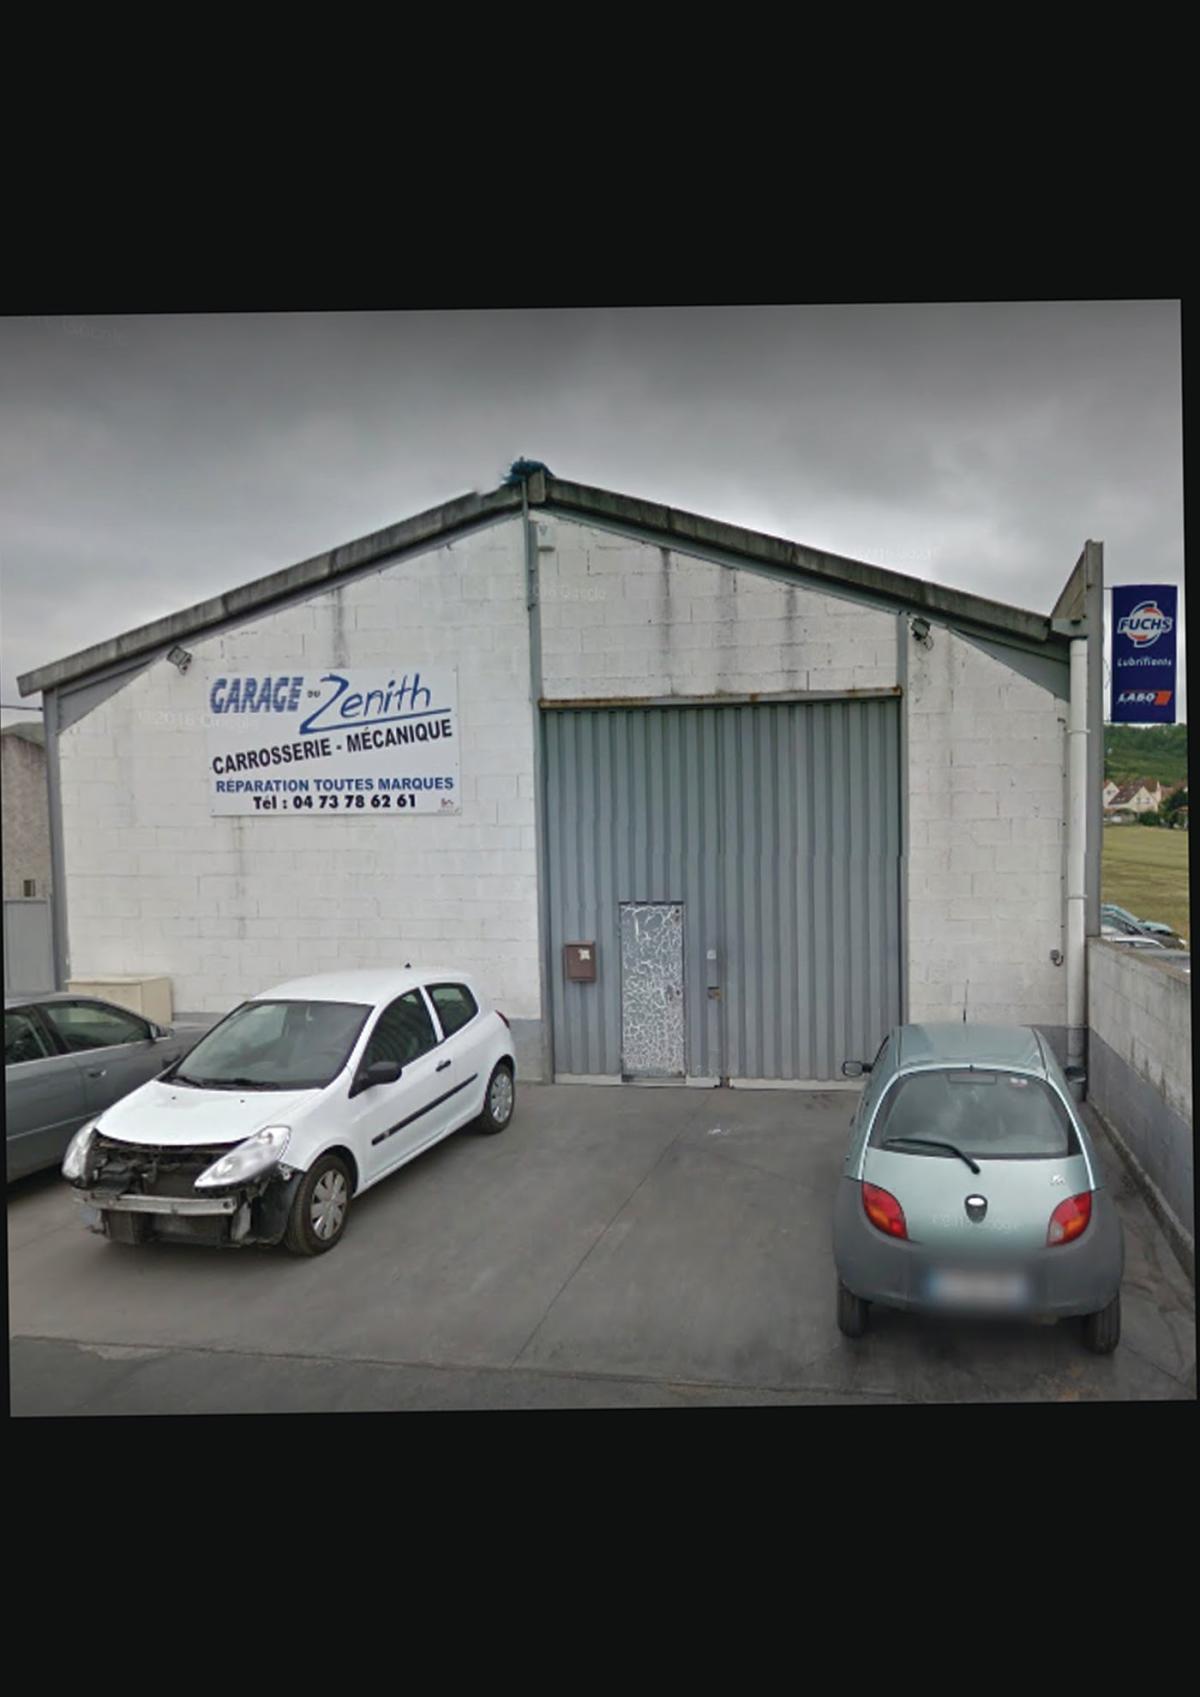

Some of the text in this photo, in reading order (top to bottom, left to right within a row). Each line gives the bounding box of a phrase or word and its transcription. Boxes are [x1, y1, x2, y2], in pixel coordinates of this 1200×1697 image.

[1119, 617, 1172, 631] FUCHS
[210, 676, 304, 714] GARAGE
[307, 690, 321, 698] DU
[1117, 692, 1155, 703] LABO
[299, 673, 452, 735] Zenith
[212, 737, 332, 775] CARROSSERIE
[346, 718, 453, 753] MÉCANIQUE
[216, 776, 454, 793] RÉPARATION TOUTES MARQUES
[253, 795, 277, 810] Tél
[293, 795, 313, 809] 04
[318, 795, 339, 809] 73
[344, 795, 365, 808] 78
[370, 795, 391, 808] 62
[397, 794, 416, 808] 61
